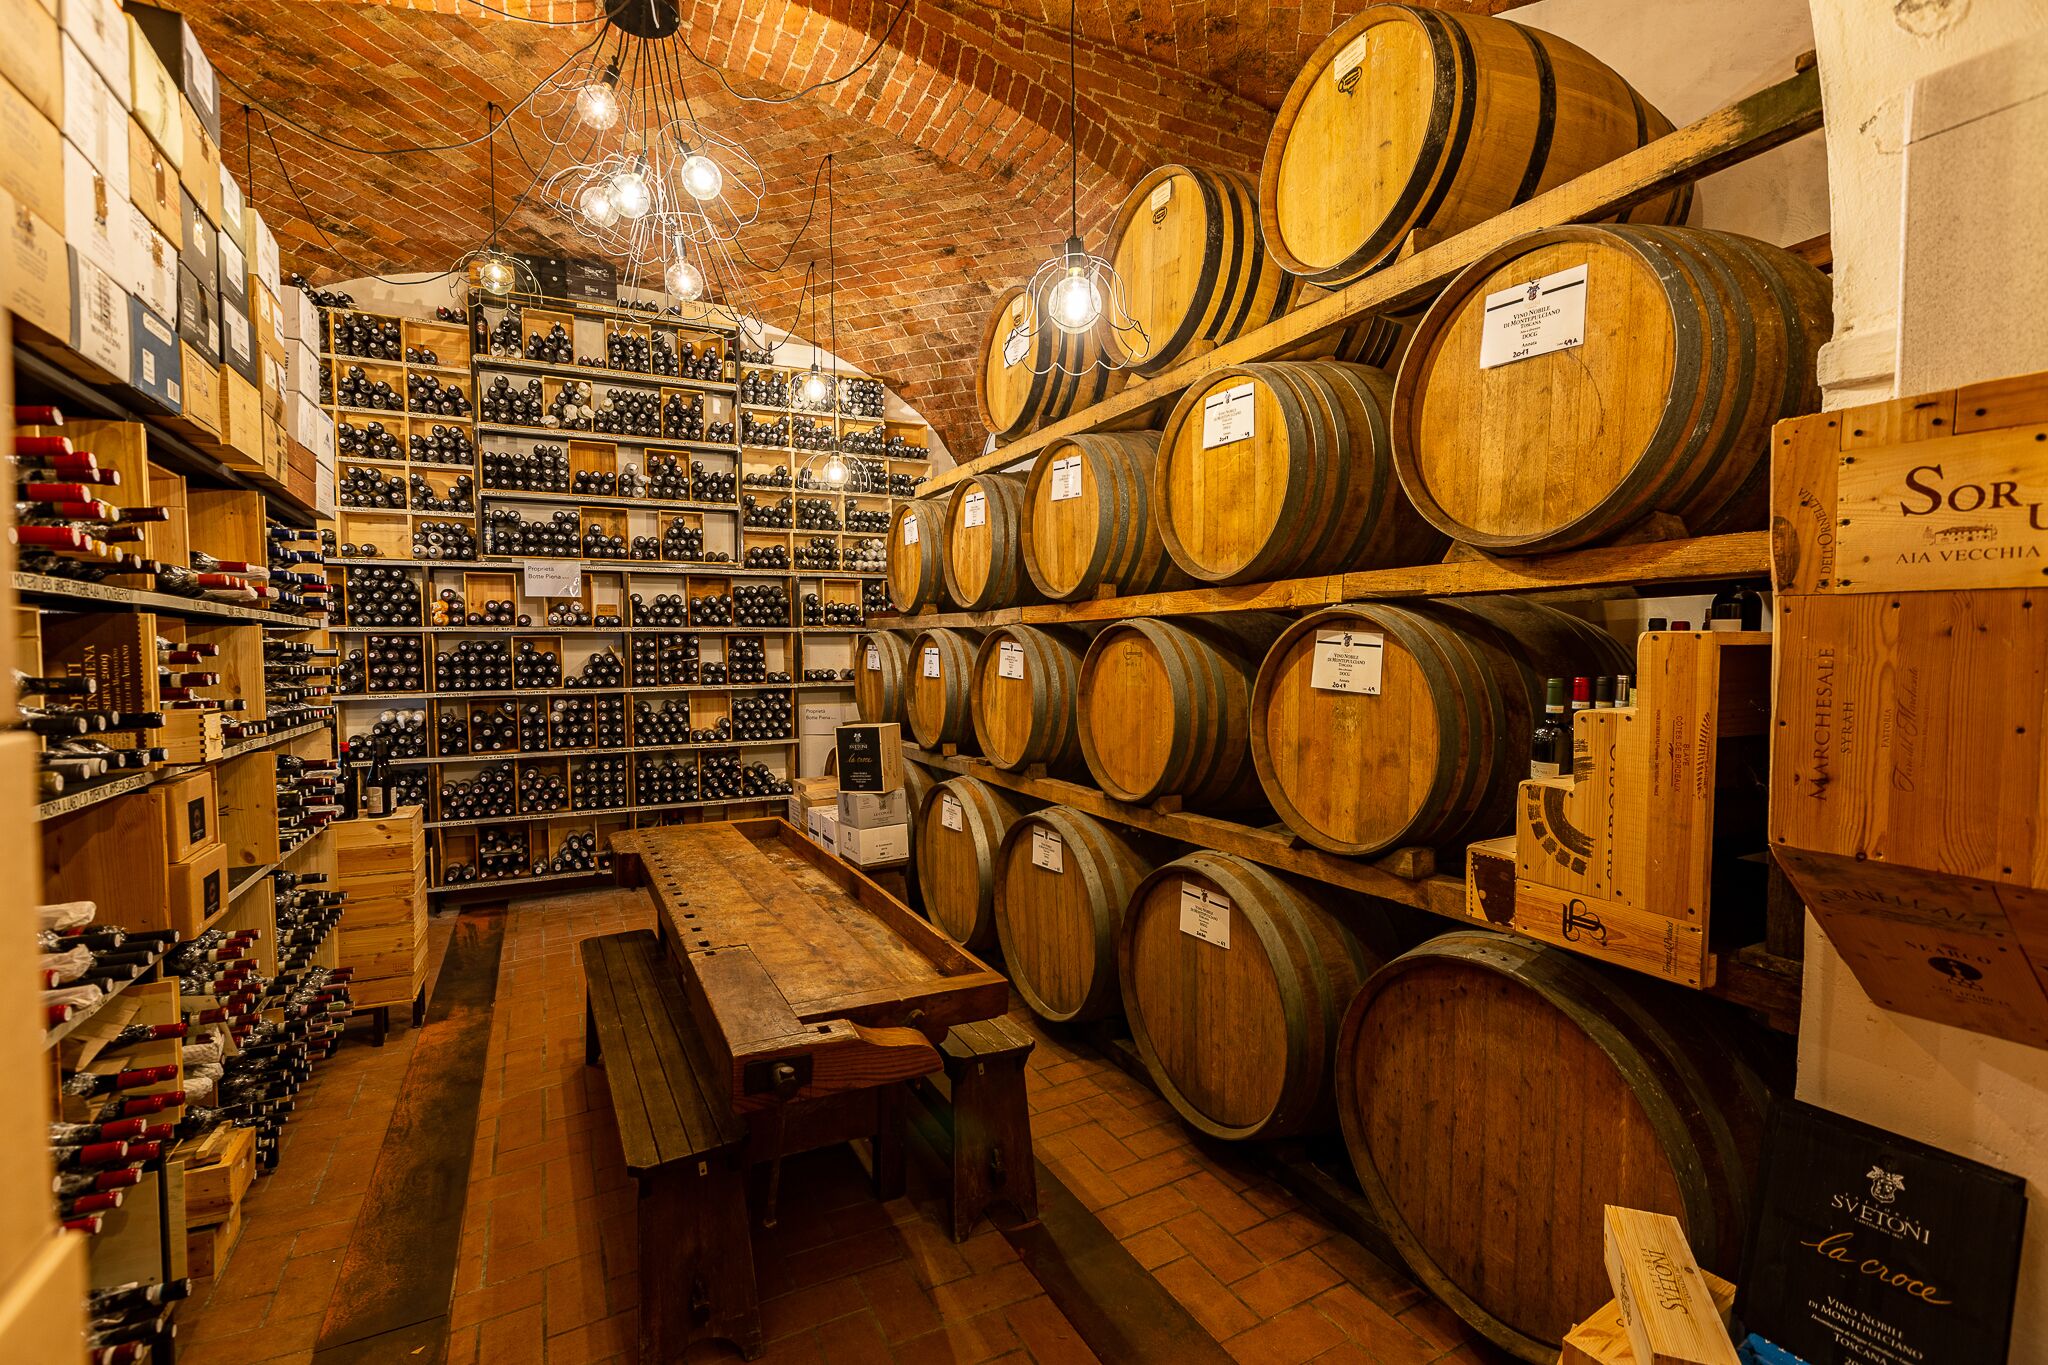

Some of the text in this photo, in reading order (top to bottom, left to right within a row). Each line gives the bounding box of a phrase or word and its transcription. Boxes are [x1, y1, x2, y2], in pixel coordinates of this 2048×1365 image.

[1896, 545, 2041, 565] AIA VECCHIA
[1807, 648, 1835, 802] MARCHESALE
[1841, 700, 1855, 755] SYRAH
[1831, 1193, 1931, 1245] SVETONI
[1647, 1249, 1689, 1315] SVETONI
[1800, 1231, 1953, 1305] la croce
[1820, 1304, 1924, 1360] MONTEPULCIANO
[1827, 1295, 1904, 1340] VINO NOBILE
